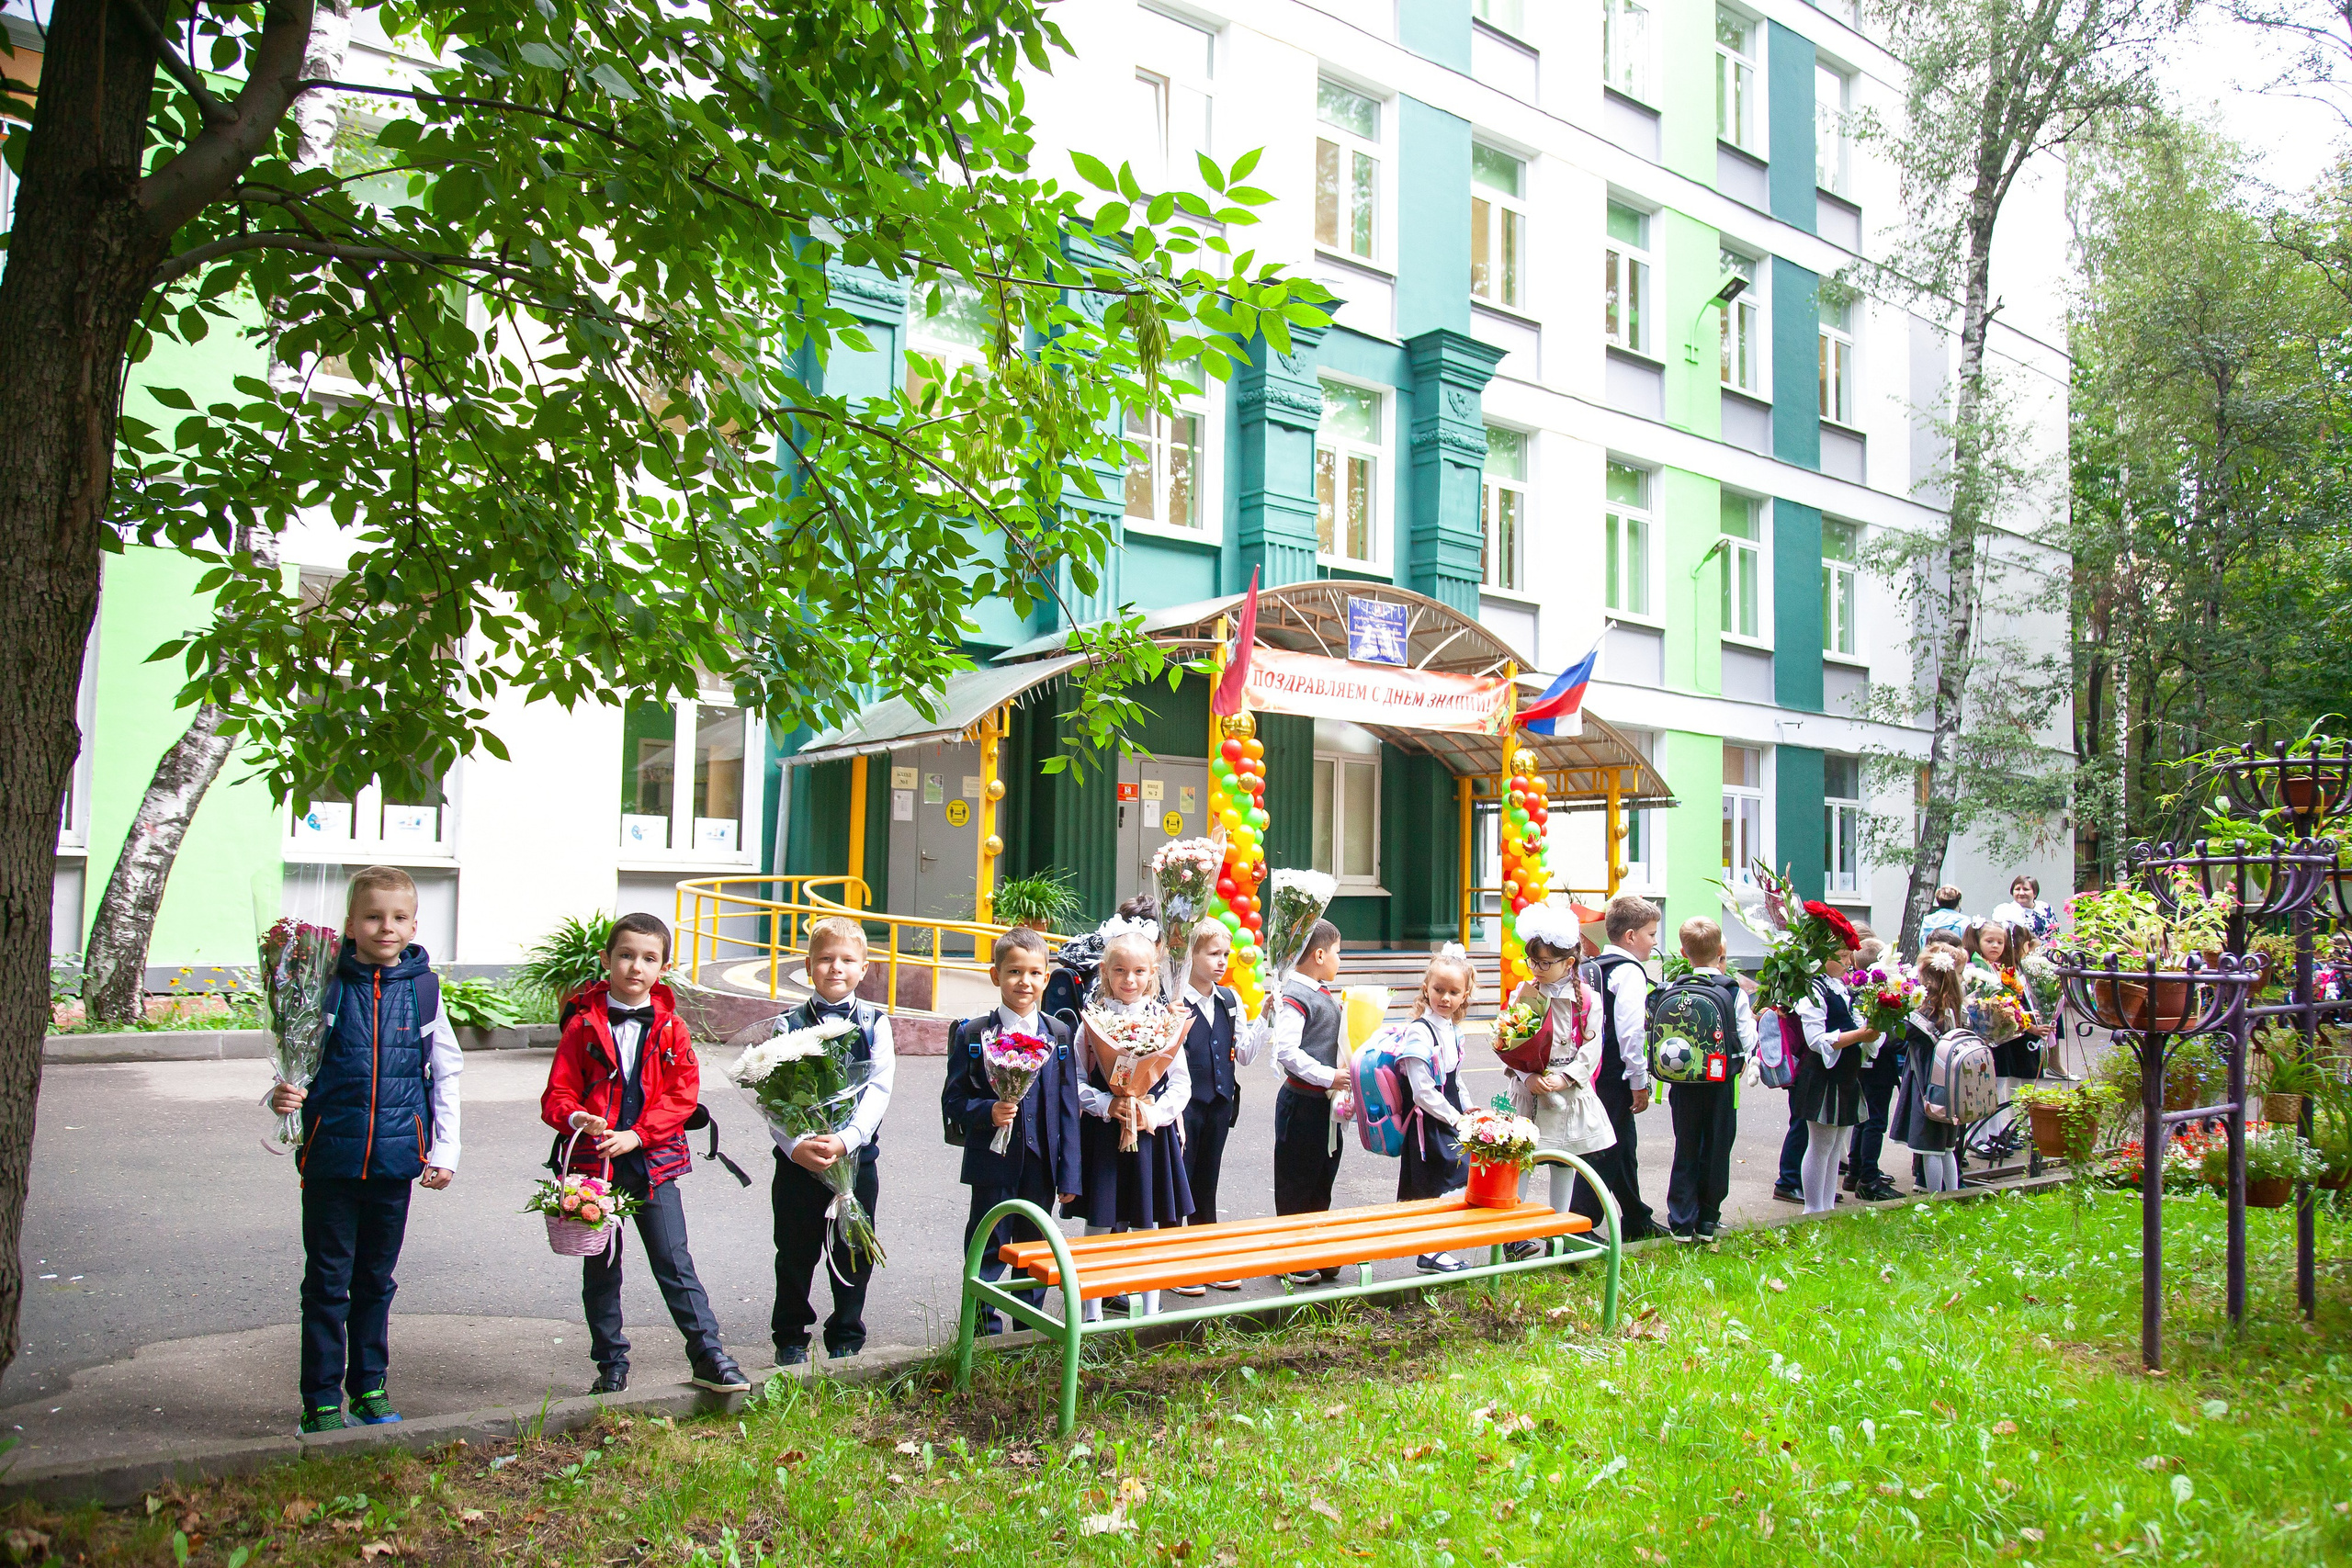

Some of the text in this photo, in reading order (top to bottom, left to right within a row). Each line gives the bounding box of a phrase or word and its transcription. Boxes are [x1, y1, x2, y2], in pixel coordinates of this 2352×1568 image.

[1253, 669, 1491, 713] ПОЗДРАВЛЯЕМ С ДНЕМ ЗНАНИЙ!
